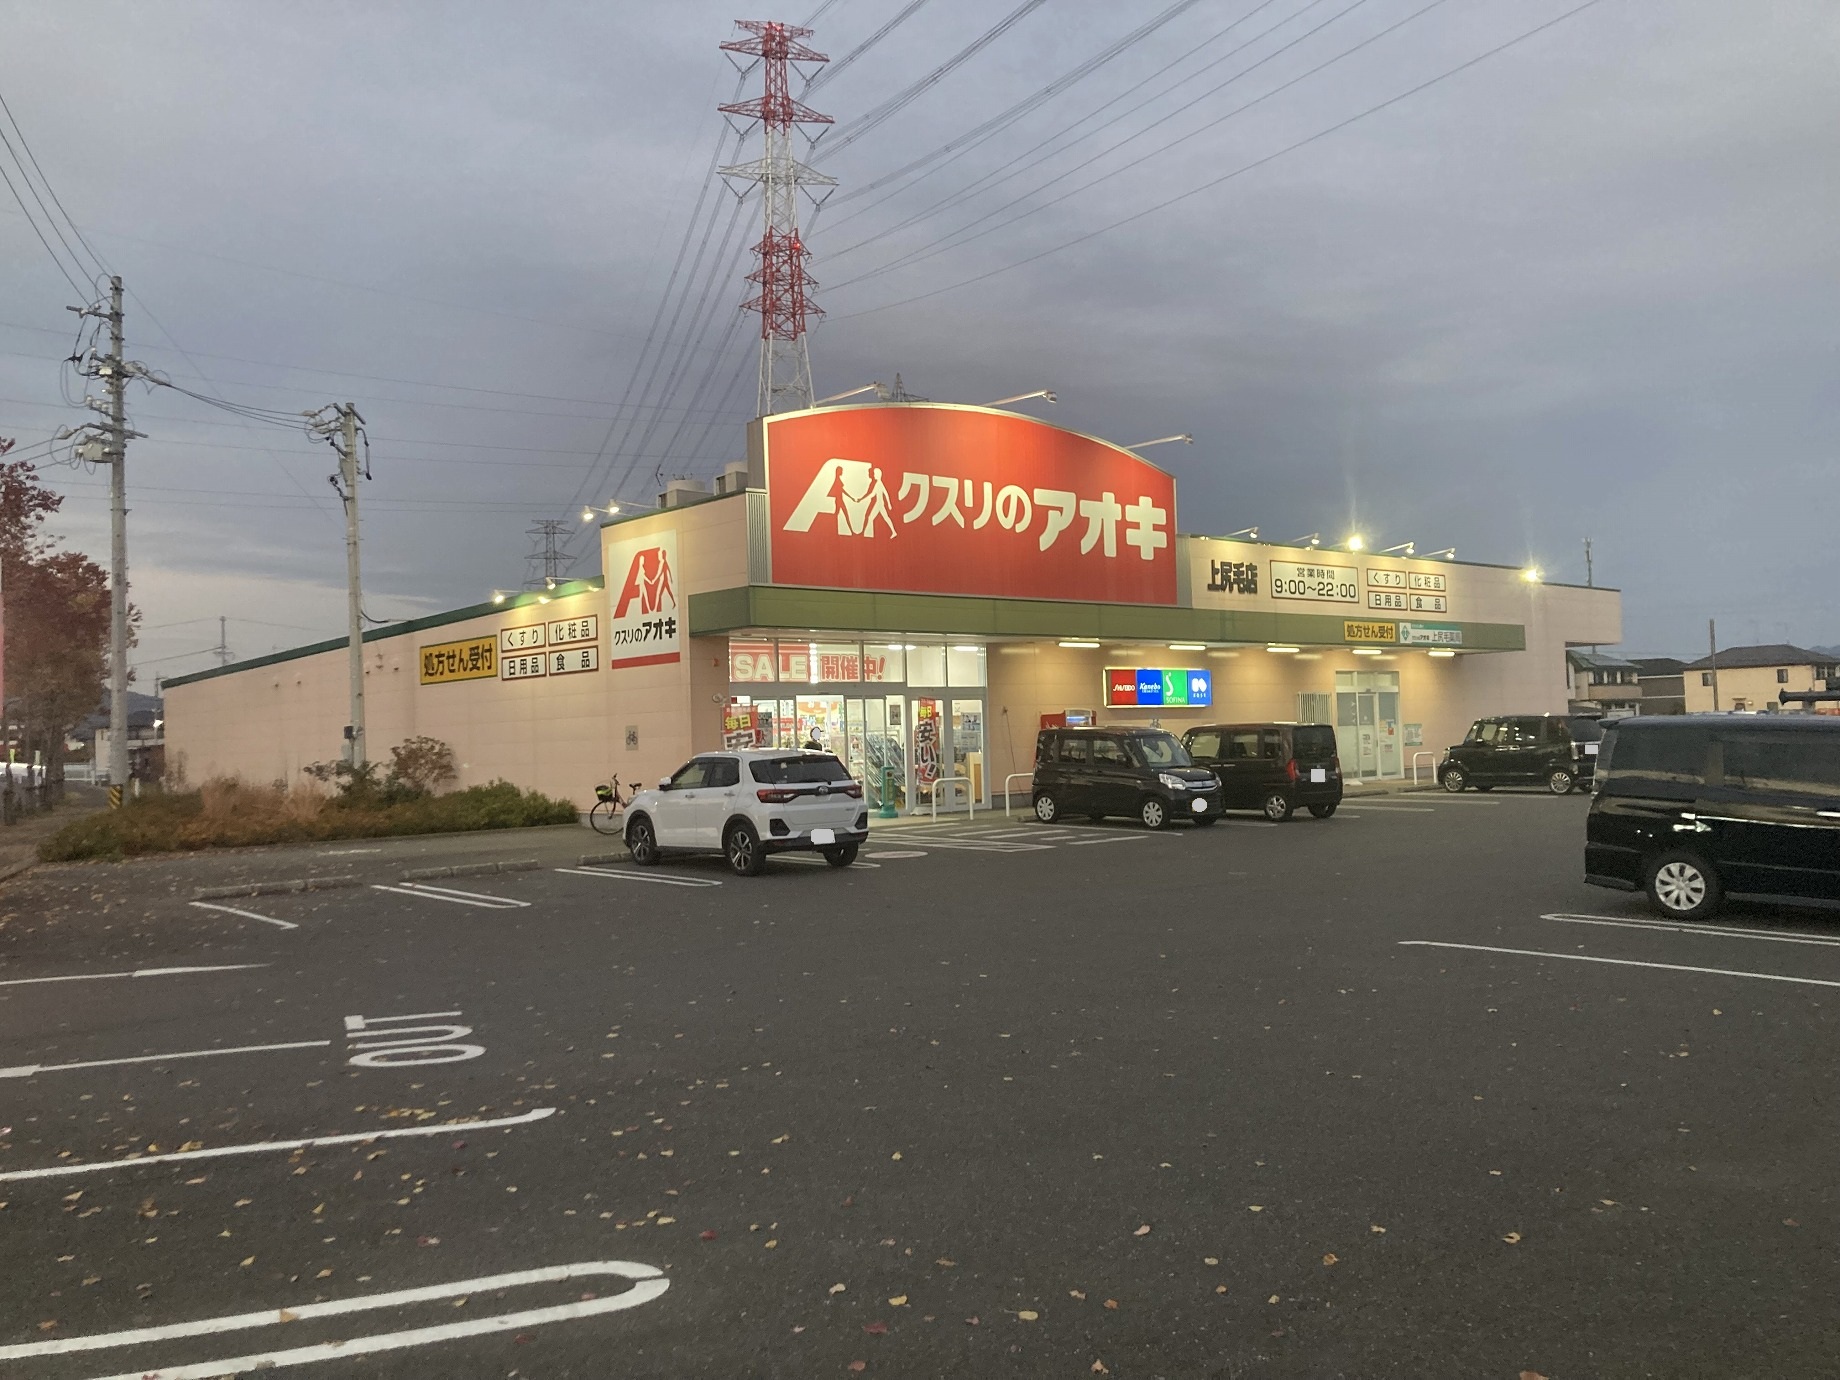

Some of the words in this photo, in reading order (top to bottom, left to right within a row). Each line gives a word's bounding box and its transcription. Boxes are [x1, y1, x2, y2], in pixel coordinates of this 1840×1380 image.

[898, 471, 1168, 561] クスリのアオキ
[1207, 559, 1258, 594] 上尻毛店
[1297, 567, 1335, 580] 営業時間
[1373, 572, 1401, 585] くすり
[1414, 575, 1441, 589] 化粧品
[1374, 594, 1402, 607] 日用品
[507, 627, 539, 647] くすり
[555, 620, 590, 642] 化粧品
[614, 616, 676, 646] クスリのアオキ
[1346, 624, 1394, 640] 処方せん受付
[424, 643, 493, 677] 処方せん受付
[508, 656, 539, 676] 日用品
[734, 653, 808, 681] SALE
[724, 713, 752, 731] 毎日
